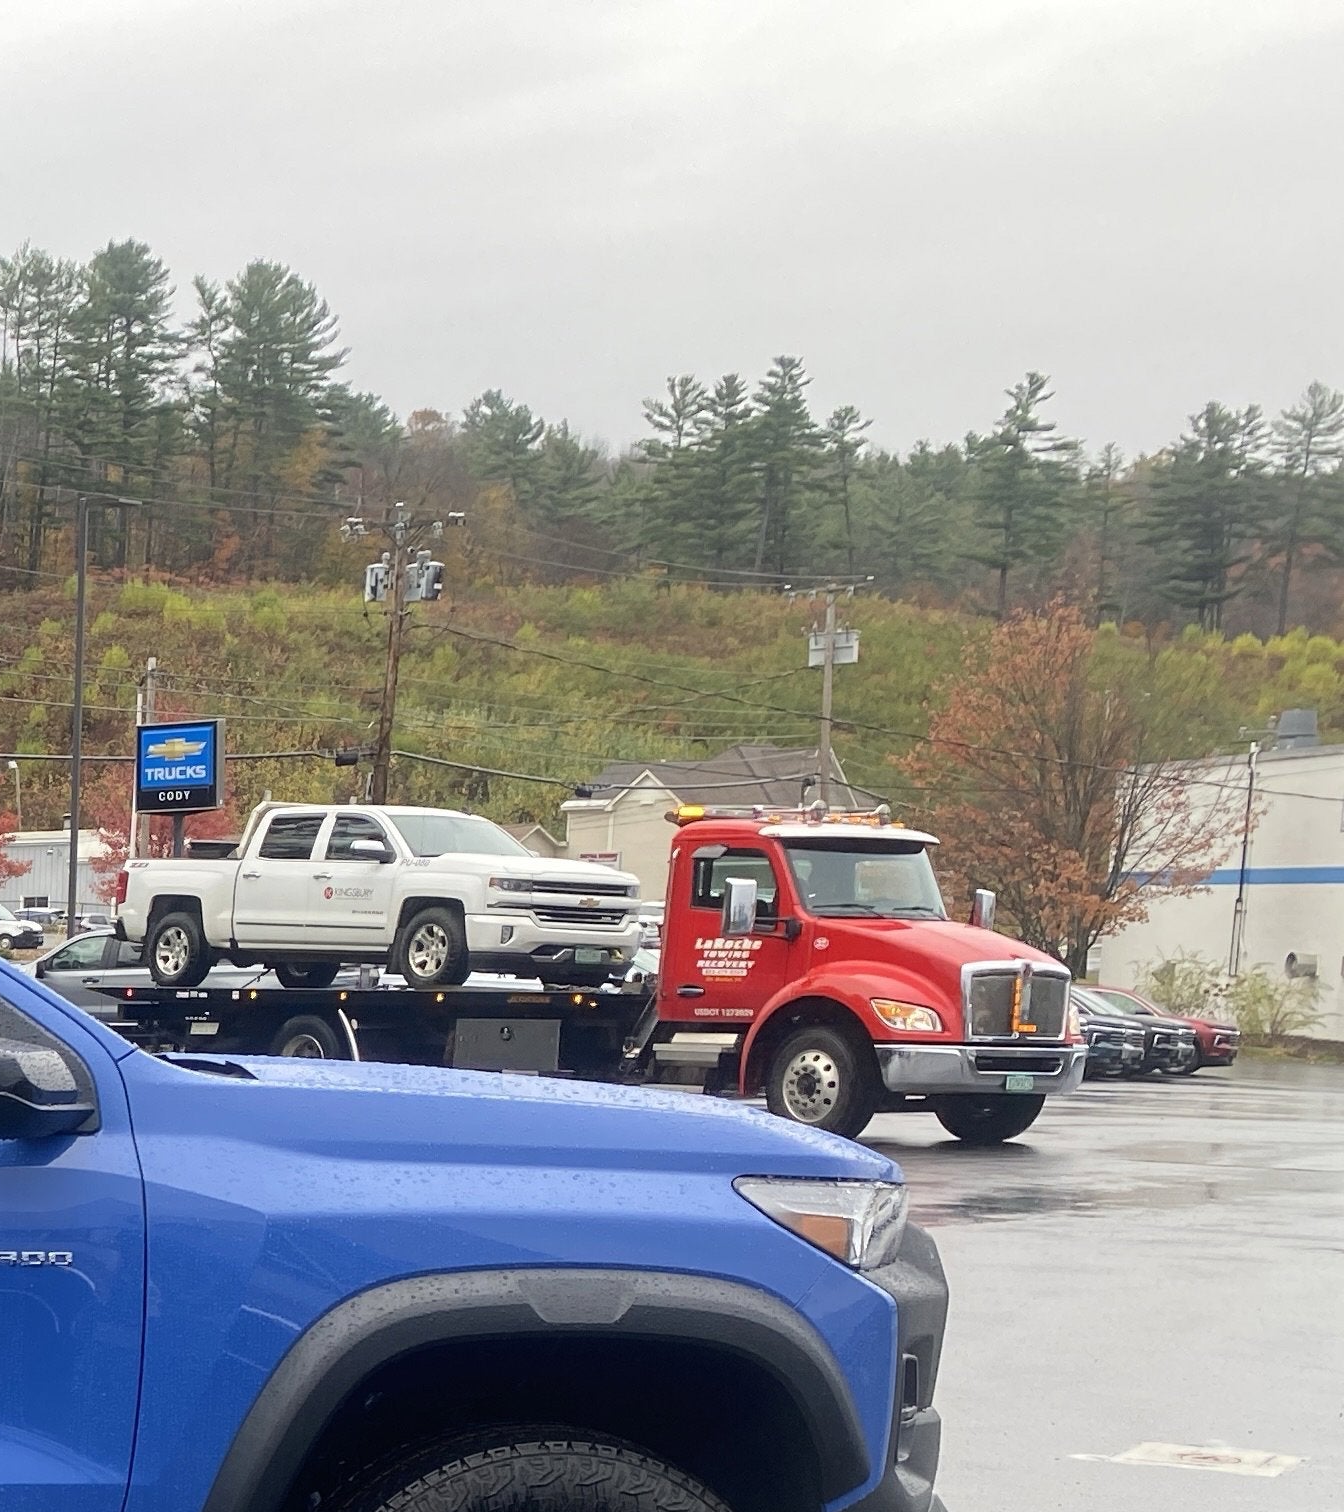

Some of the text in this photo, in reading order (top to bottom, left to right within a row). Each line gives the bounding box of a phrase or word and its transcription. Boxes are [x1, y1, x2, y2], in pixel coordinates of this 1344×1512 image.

[145, 765, 207, 781] TRUCKS
[158, 791, 191, 801] CODY
[334, 887, 374, 898] KINGSBURY
[695, 938, 763, 950] LaRoche
[703, 950, 750, 958] TOWING
[696, 960, 756, 969] RECOVERY
